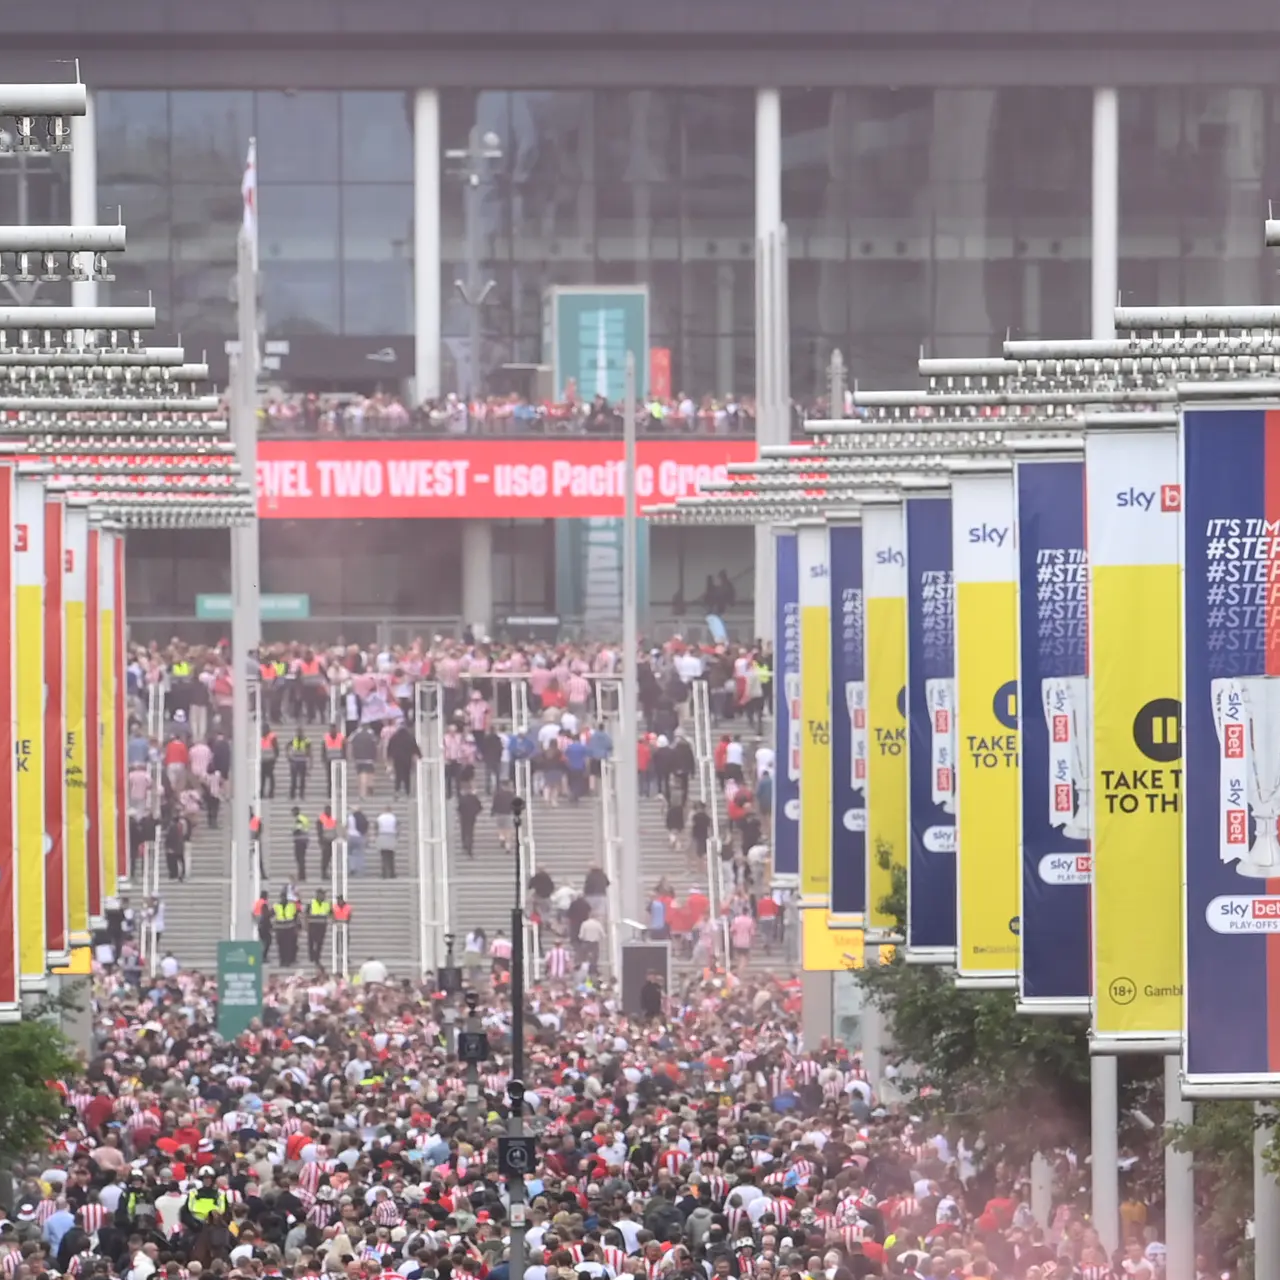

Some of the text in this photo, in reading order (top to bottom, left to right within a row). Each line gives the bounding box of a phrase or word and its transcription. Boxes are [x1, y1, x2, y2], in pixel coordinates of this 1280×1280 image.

[315, 459, 384, 498] TWO
[386, 459, 470, 498] WEST
[494, 462, 548, 497] use
[1116, 486, 1157, 512] sky
[968, 523, 1009, 548] sky
[1205, 518, 1241, 537] IT'S
[1225, 692, 1243, 756] sky bet
[880, 743, 901, 756] TO
[966, 735, 1016, 751] TAKE
[972, 753, 998, 769] TO
[1100, 769, 1164, 790] TAKE
[1105, 793, 1139, 814] TO
[1227, 778, 1244, 841] sky bet
[1220, 901, 1249, 918] sky
[1112, 985, 1134, 997] 18+
